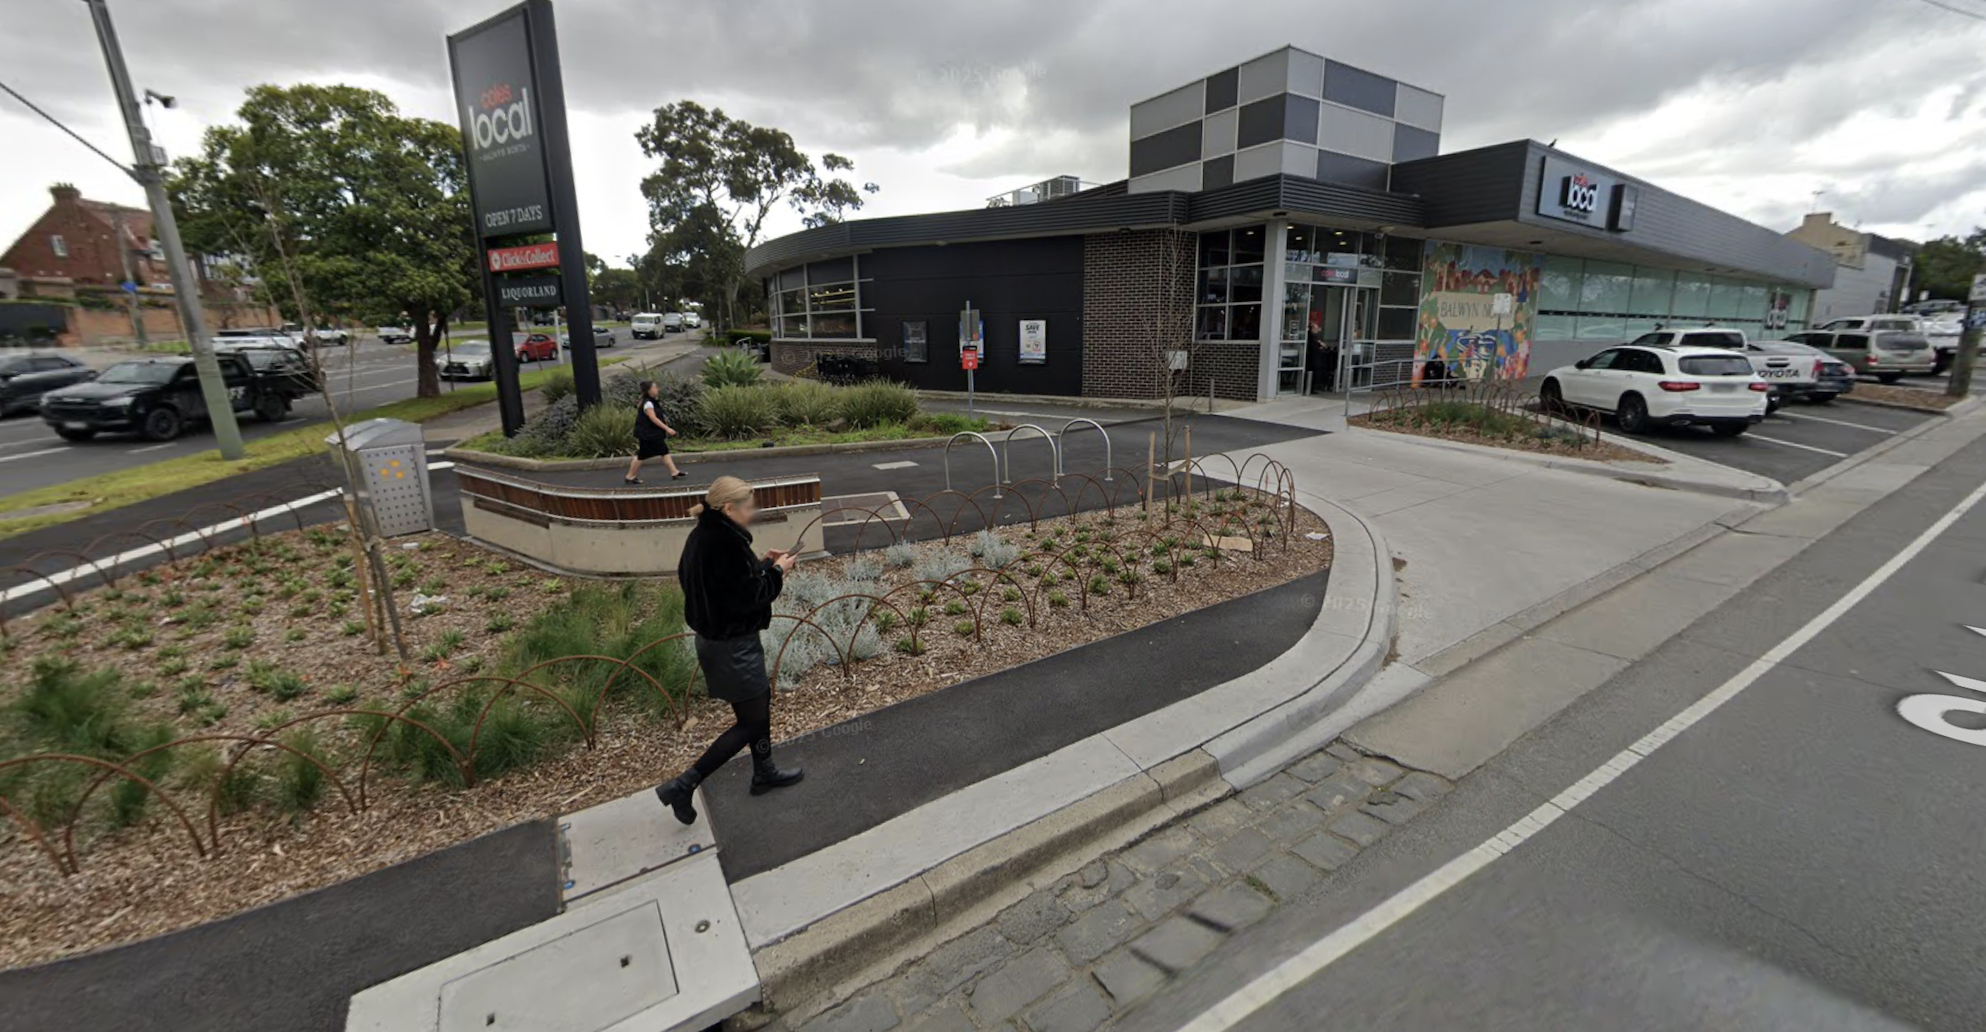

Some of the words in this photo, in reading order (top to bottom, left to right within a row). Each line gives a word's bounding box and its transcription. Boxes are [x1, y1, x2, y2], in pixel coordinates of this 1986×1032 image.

[468, 86, 533, 150] local
[485, 209, 509, 228] OPEN
[509, 208, 516, 223] 7
[517, 204, 543, 222] DAYS
[501, 285, 557, 301] LIQUORLAND
[1441, 302, 1479, 318] BALWYN
